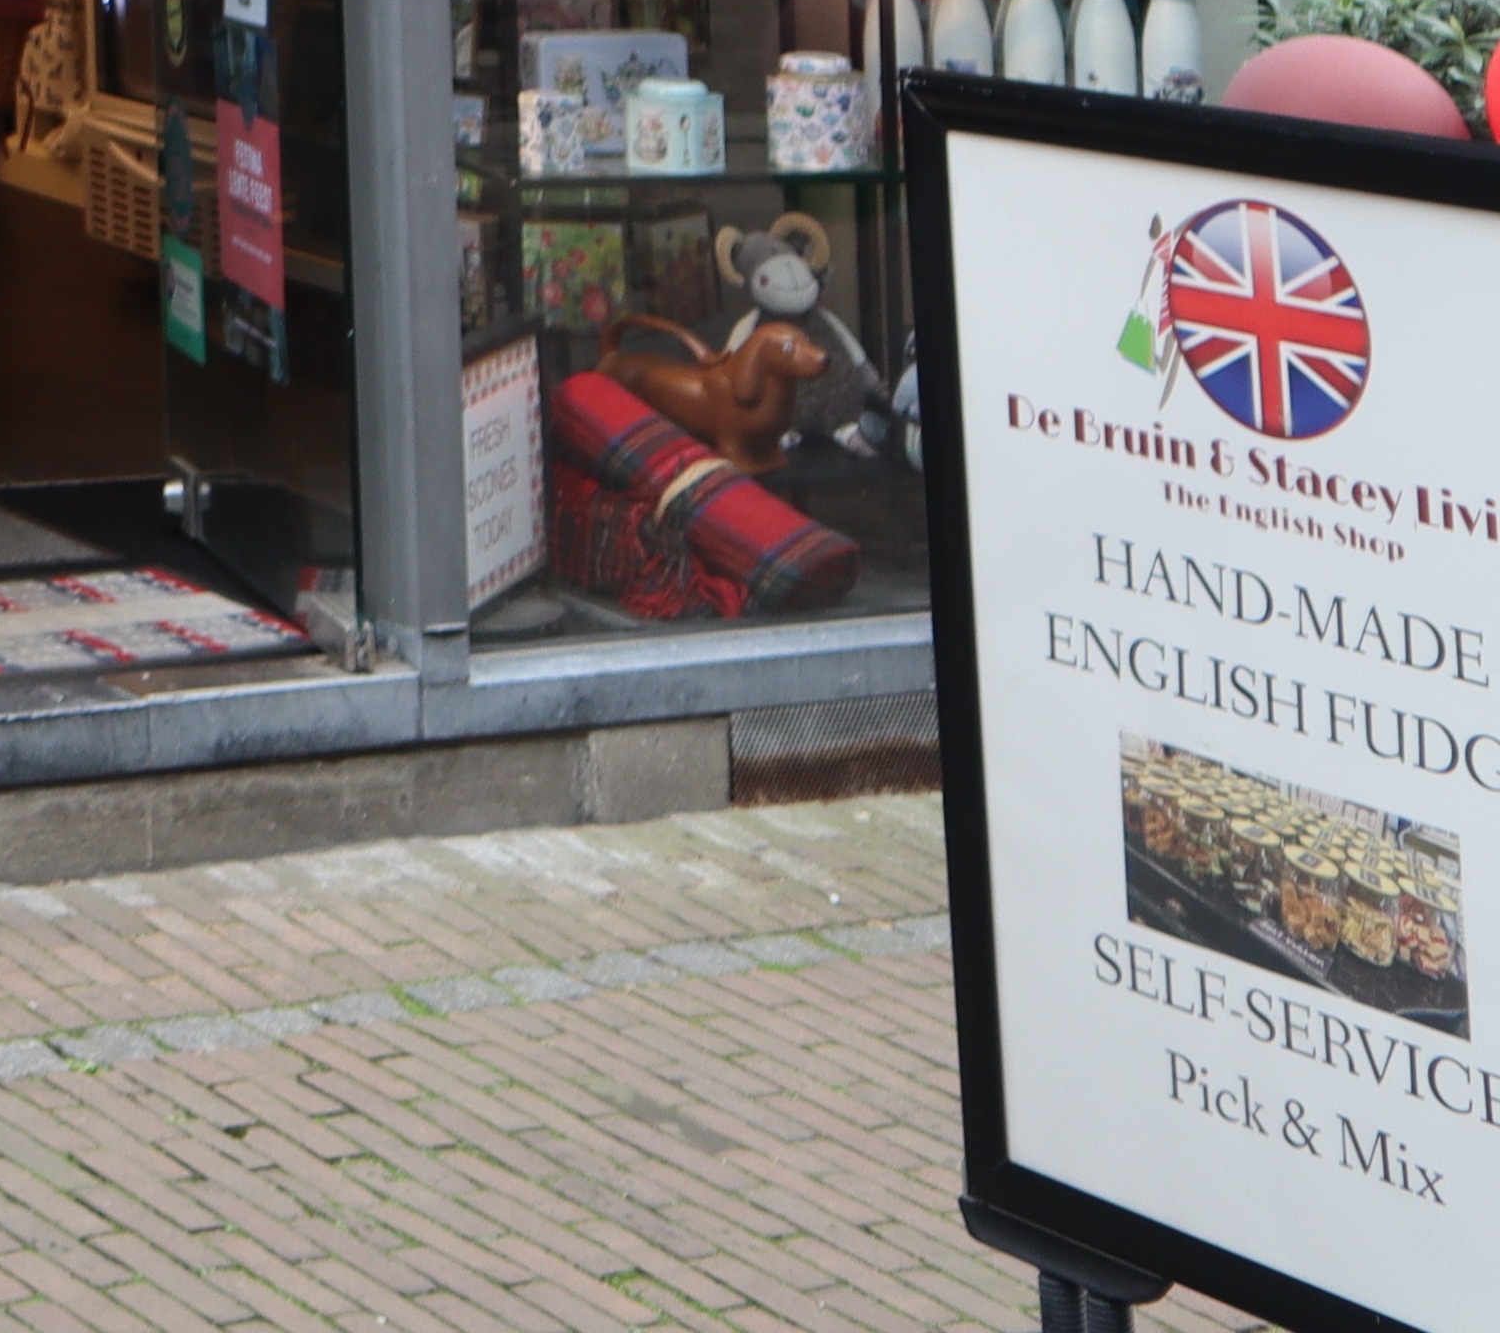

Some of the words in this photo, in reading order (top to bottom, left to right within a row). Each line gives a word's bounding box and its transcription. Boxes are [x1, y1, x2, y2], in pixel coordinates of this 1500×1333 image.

[471, 414, 511, 460] FRESH
[1007, 393, 1061, 439] De
[1073, 407, 1196, 470] Bruin
[1210, 438, 1235, 478] &
[1248, 447, 1403, 524] Stacey
[474, 503, 513, 552] TODAY
[1161, 480, 1211, 513] The
[1219, 494, 1324, 541] English
[1333, 523, 1406, 563] Shop
[1092, 533, 1490, 688] HAND-MADE
[1045, 611, 1309, 735] ENGLISH
[1165, 1048, 1268, 1136] Pick
[1282, 1099, 1321, 1157] &
[1337, 1113, 1446, 1206] Mix
